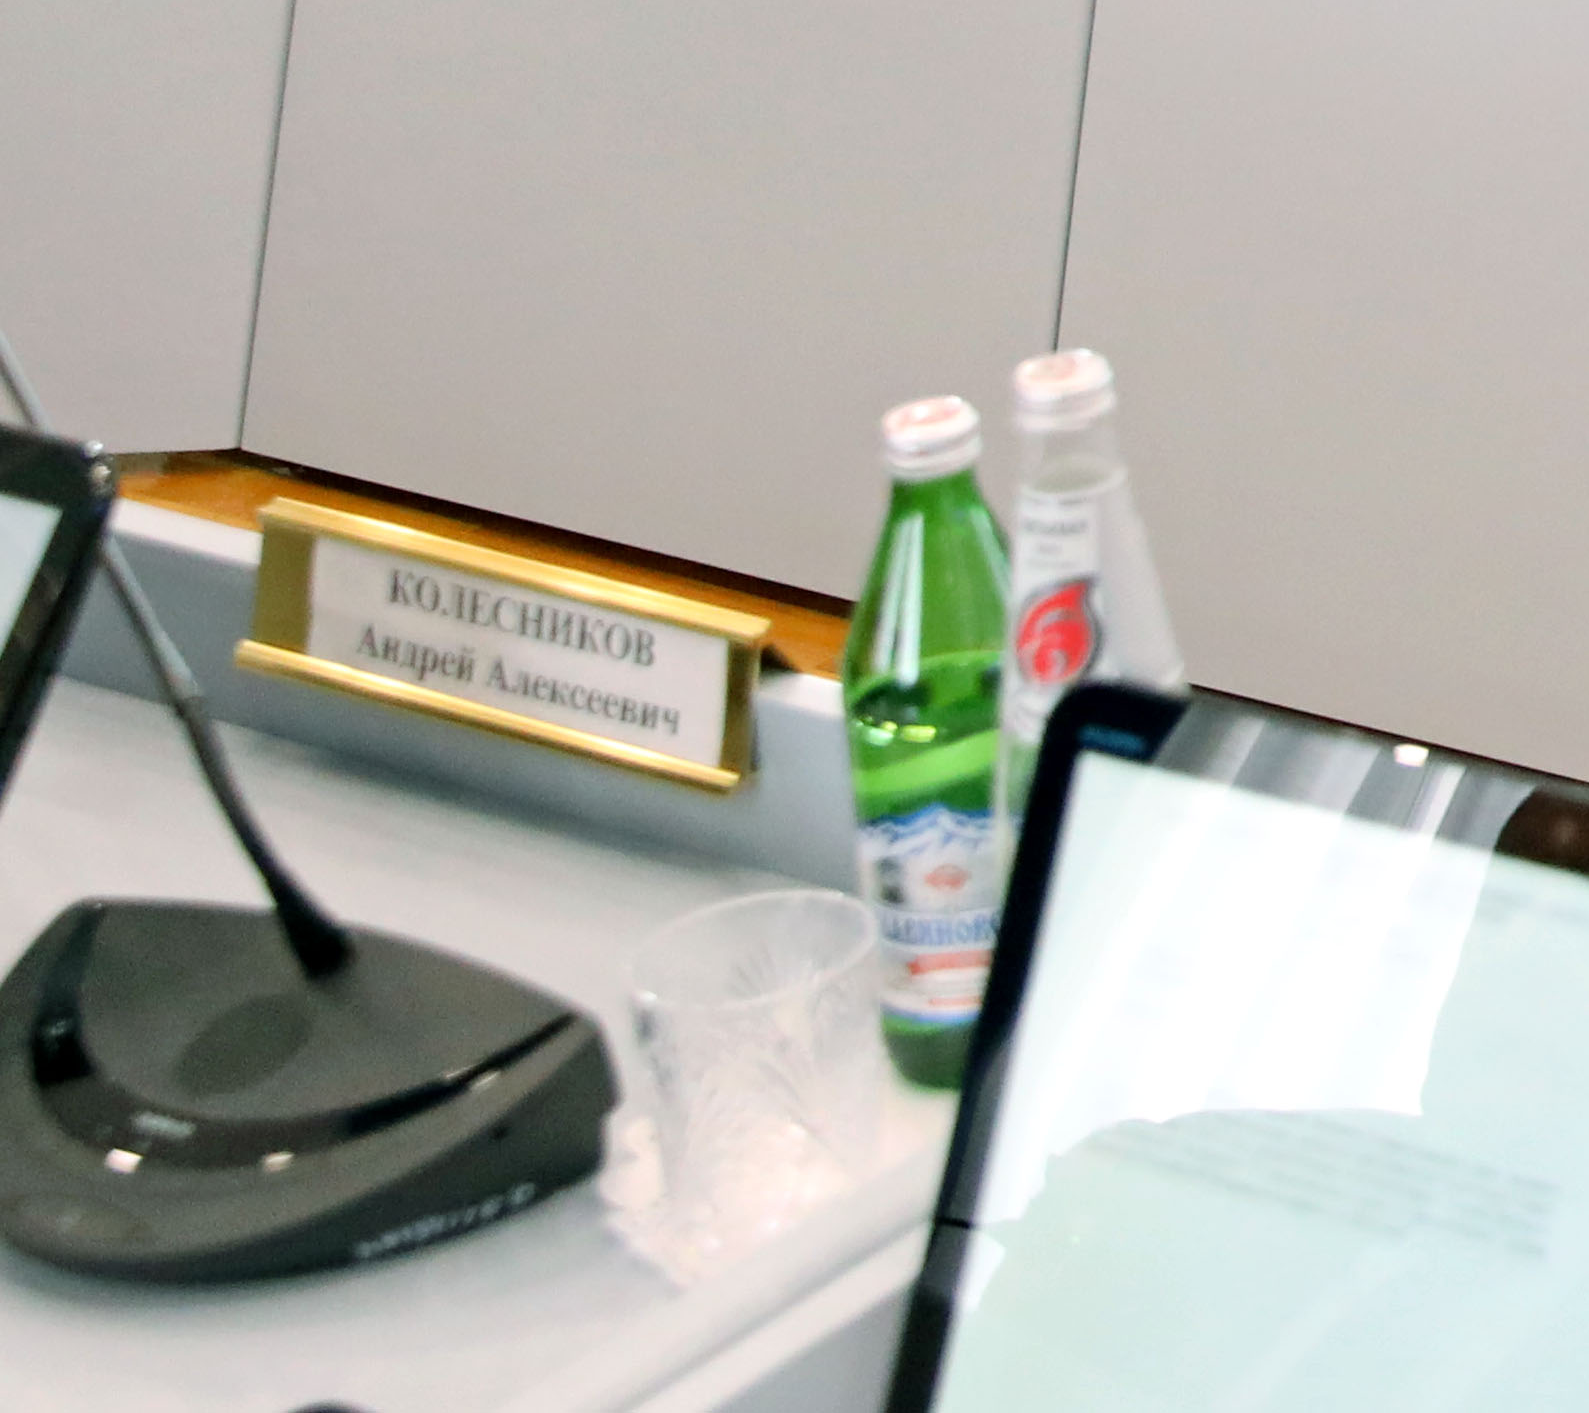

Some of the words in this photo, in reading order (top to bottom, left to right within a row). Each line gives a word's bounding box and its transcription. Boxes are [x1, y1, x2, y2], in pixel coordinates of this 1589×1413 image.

[388, 568, 657, 667] КОЛЕСНИКОВ
[356, 623, 476, 682] Андрей
[486, 656, 681, 735] Алексеевич
